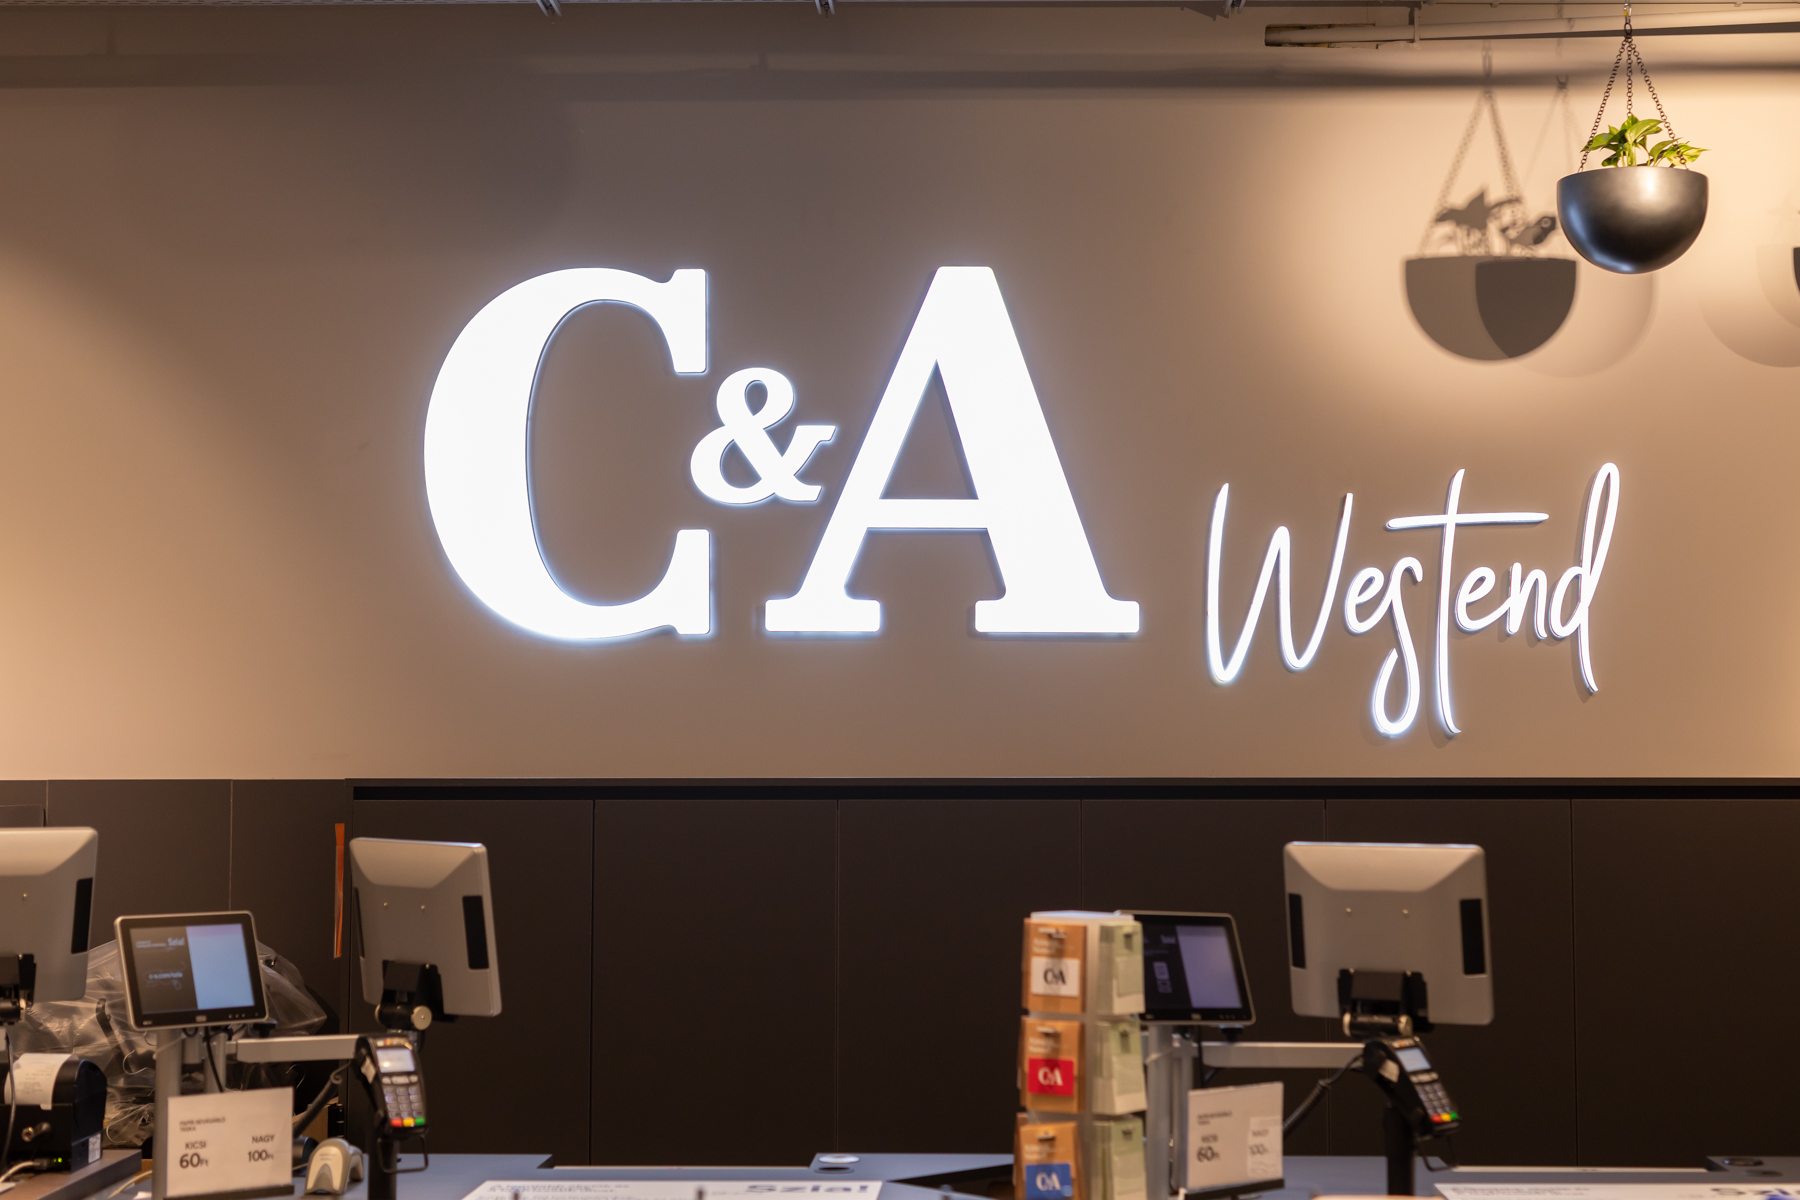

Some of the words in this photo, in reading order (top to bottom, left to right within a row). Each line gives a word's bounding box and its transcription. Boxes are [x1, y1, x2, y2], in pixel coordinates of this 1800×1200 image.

[424, 267, 1140, 639] C&A
[1207, 463, 1619, 737] Westend
[251, 1134, 275, 1144] NAGY
[185, 1140, 206, 1150] KICSI
